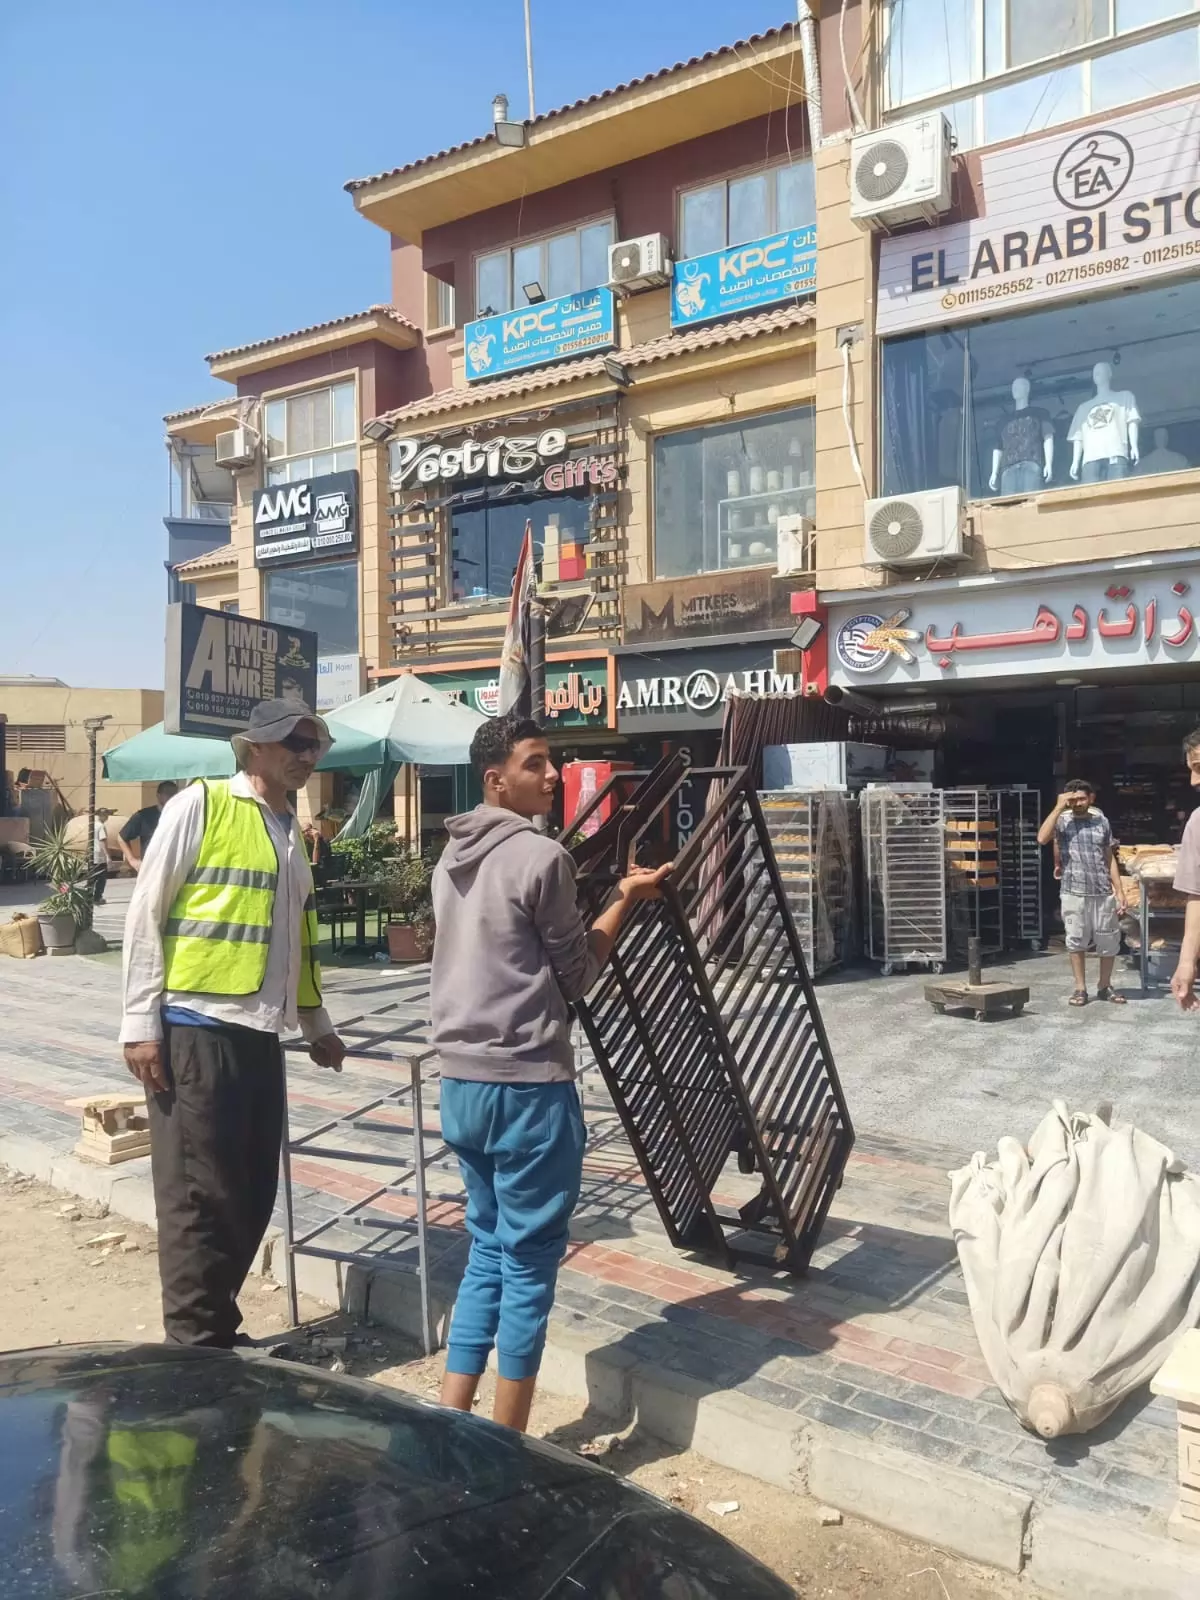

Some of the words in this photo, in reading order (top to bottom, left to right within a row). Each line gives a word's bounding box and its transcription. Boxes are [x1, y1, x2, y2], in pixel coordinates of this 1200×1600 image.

[719, 236, 789, 282] KPC
[911, 249, 960, 293] EL
[970, 211, 1107, 279] ARABI
[719, 280, 753, 295] الطبية
[957, 277, 1033, 305] 01115525552
[1046, 256, 1129, 286] 01271556982
[502, 303, 559, 343] KPC
[561, 294, 601, 314] عيادات
[543, 457, 617, 492] Gifts
[255, 484, 311, 524] AMG
[314, 504, 349, 521] AMG
[925, 604, 1088, 669] دهب
[228, 646, 261, 669] AND
[579, 678, 602, 716] بن
[616, 677, 685, 709] AMR
[720, 669, 803, 702] AHM
[676, 747, 694, 850] SLON
